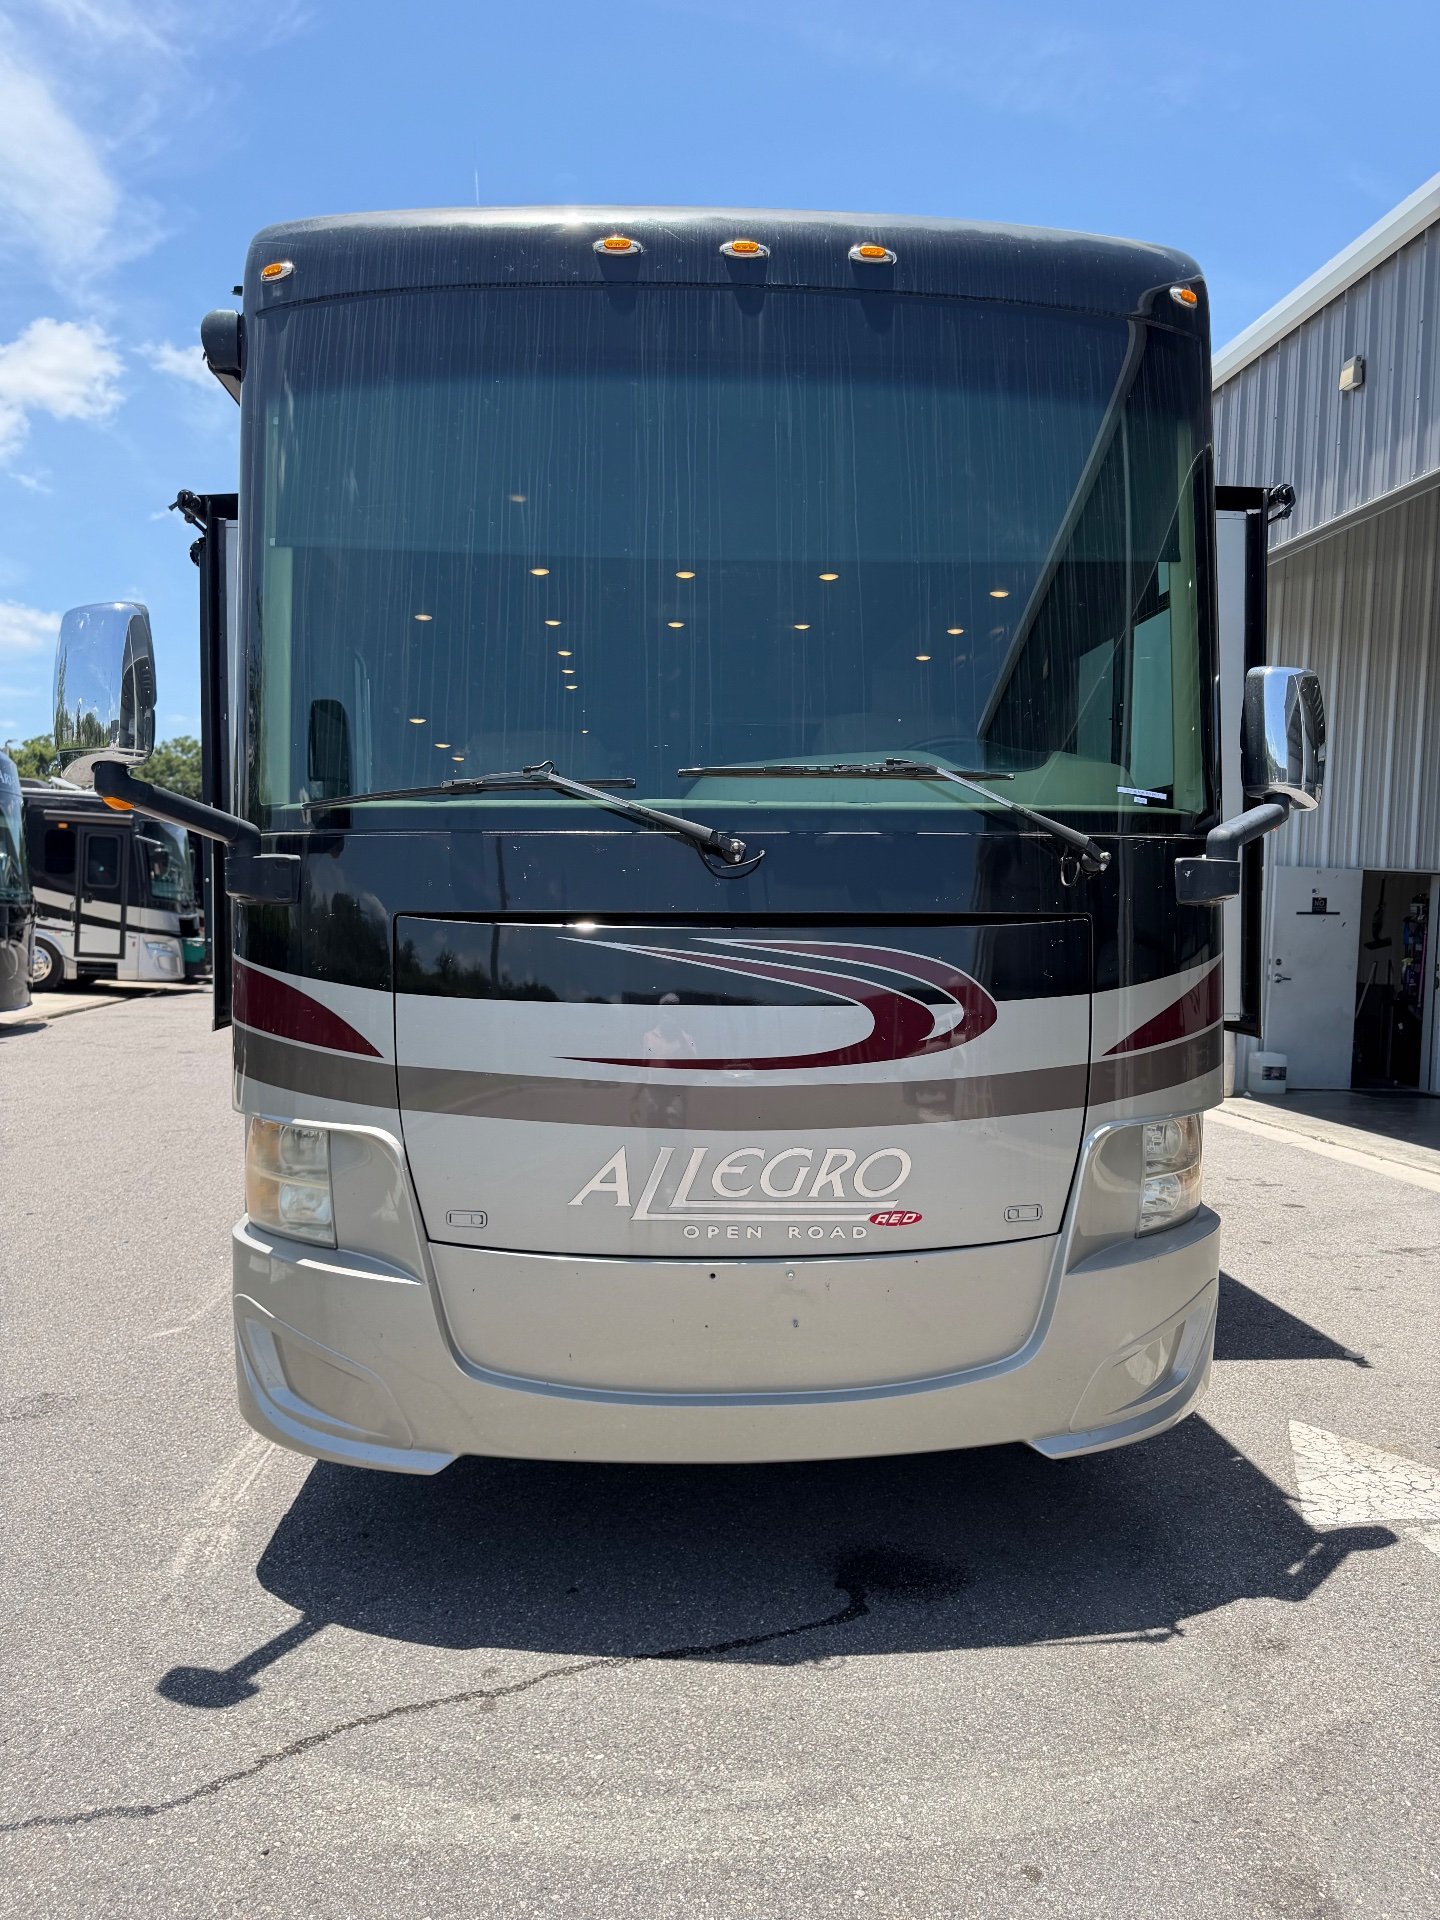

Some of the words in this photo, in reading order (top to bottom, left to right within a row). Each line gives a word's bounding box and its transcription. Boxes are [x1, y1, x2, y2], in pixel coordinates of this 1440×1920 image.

[567, 1145, 912, 1221] ALLEGRO
[873, 1212, 919, 1225] RED
[683, 1225, 763, 1239] OPEN
[788, 1225, 867, 1239] ROAD
